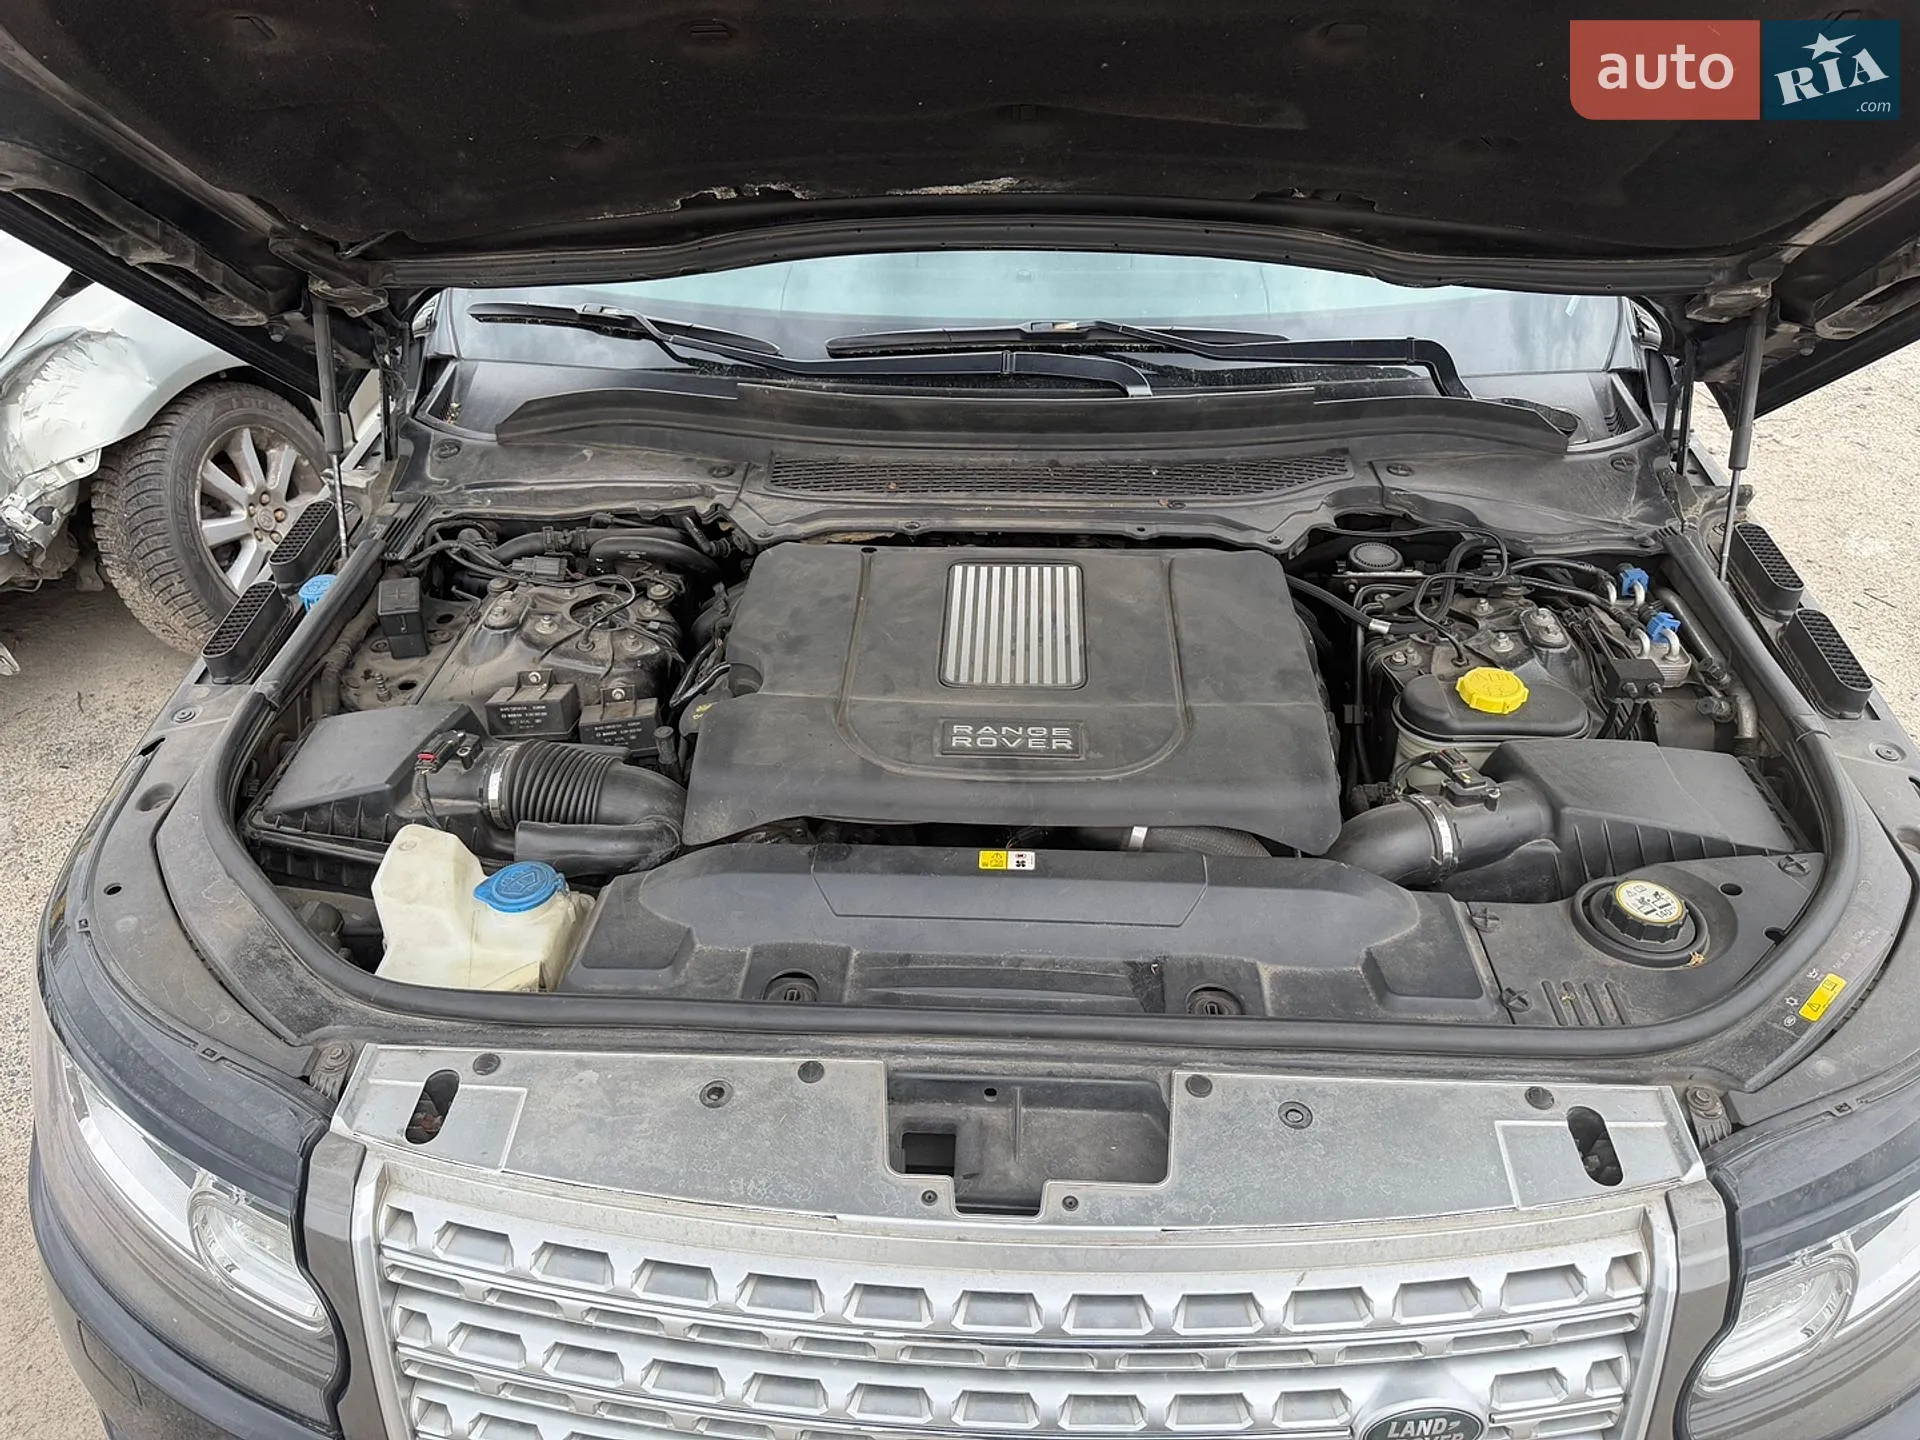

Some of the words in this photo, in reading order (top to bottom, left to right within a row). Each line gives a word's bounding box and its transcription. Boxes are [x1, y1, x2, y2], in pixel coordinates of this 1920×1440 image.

[953, 725, 1071, 736] RANGE
[951, 736, 1073, 750] ROVER
[1387, 1417, 1448, 1438] LAND
